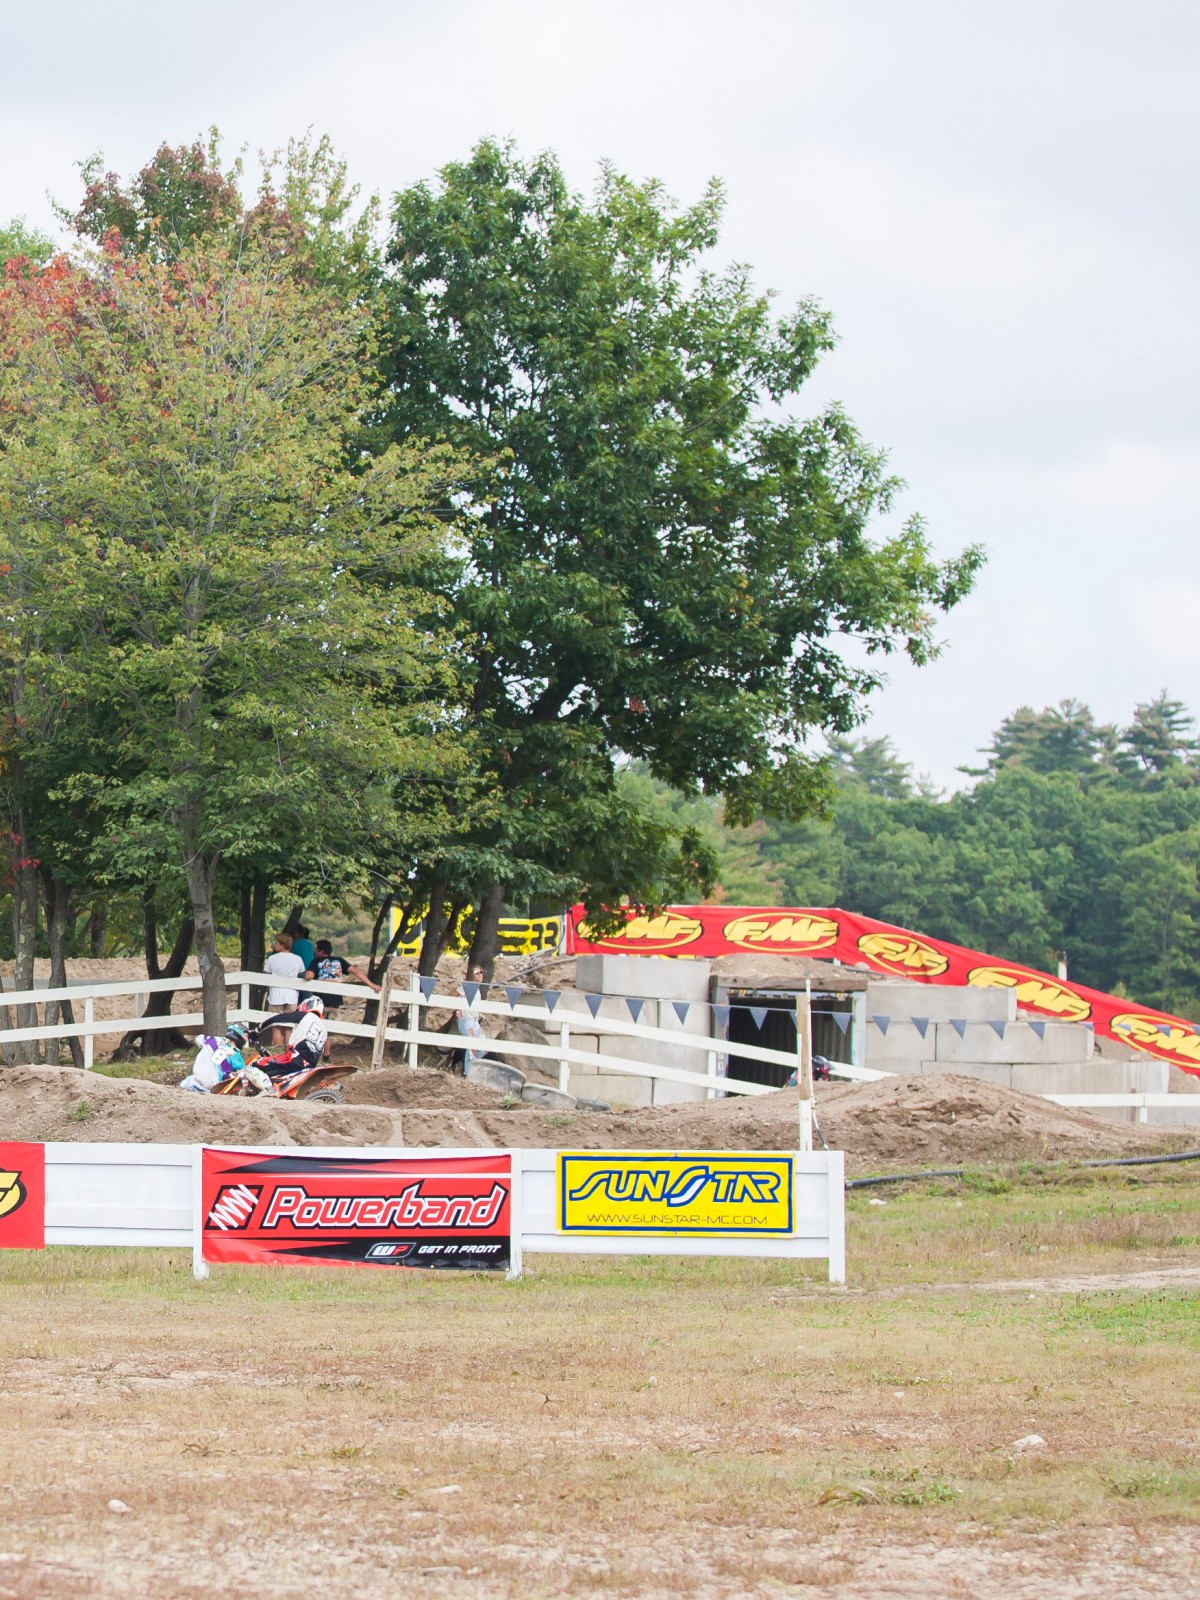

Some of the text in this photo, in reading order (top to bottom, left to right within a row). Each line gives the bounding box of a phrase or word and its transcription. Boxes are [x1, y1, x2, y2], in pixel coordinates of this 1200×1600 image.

[579, 915, 702, 939] MF
[726, 918, 838, 941] FMF
[1111, 1016, 1200, 1061] FM
[569, 1166, 781, 1207] SUNSTAR
[259, 1179, 509, 1230] Powerband
[587, 1214, 768, 1225] WWW.SUNSTAR-MC.COM
[418, 1246, 444, 1254] GET
[459, 1245, 501, 1253] FRONT
